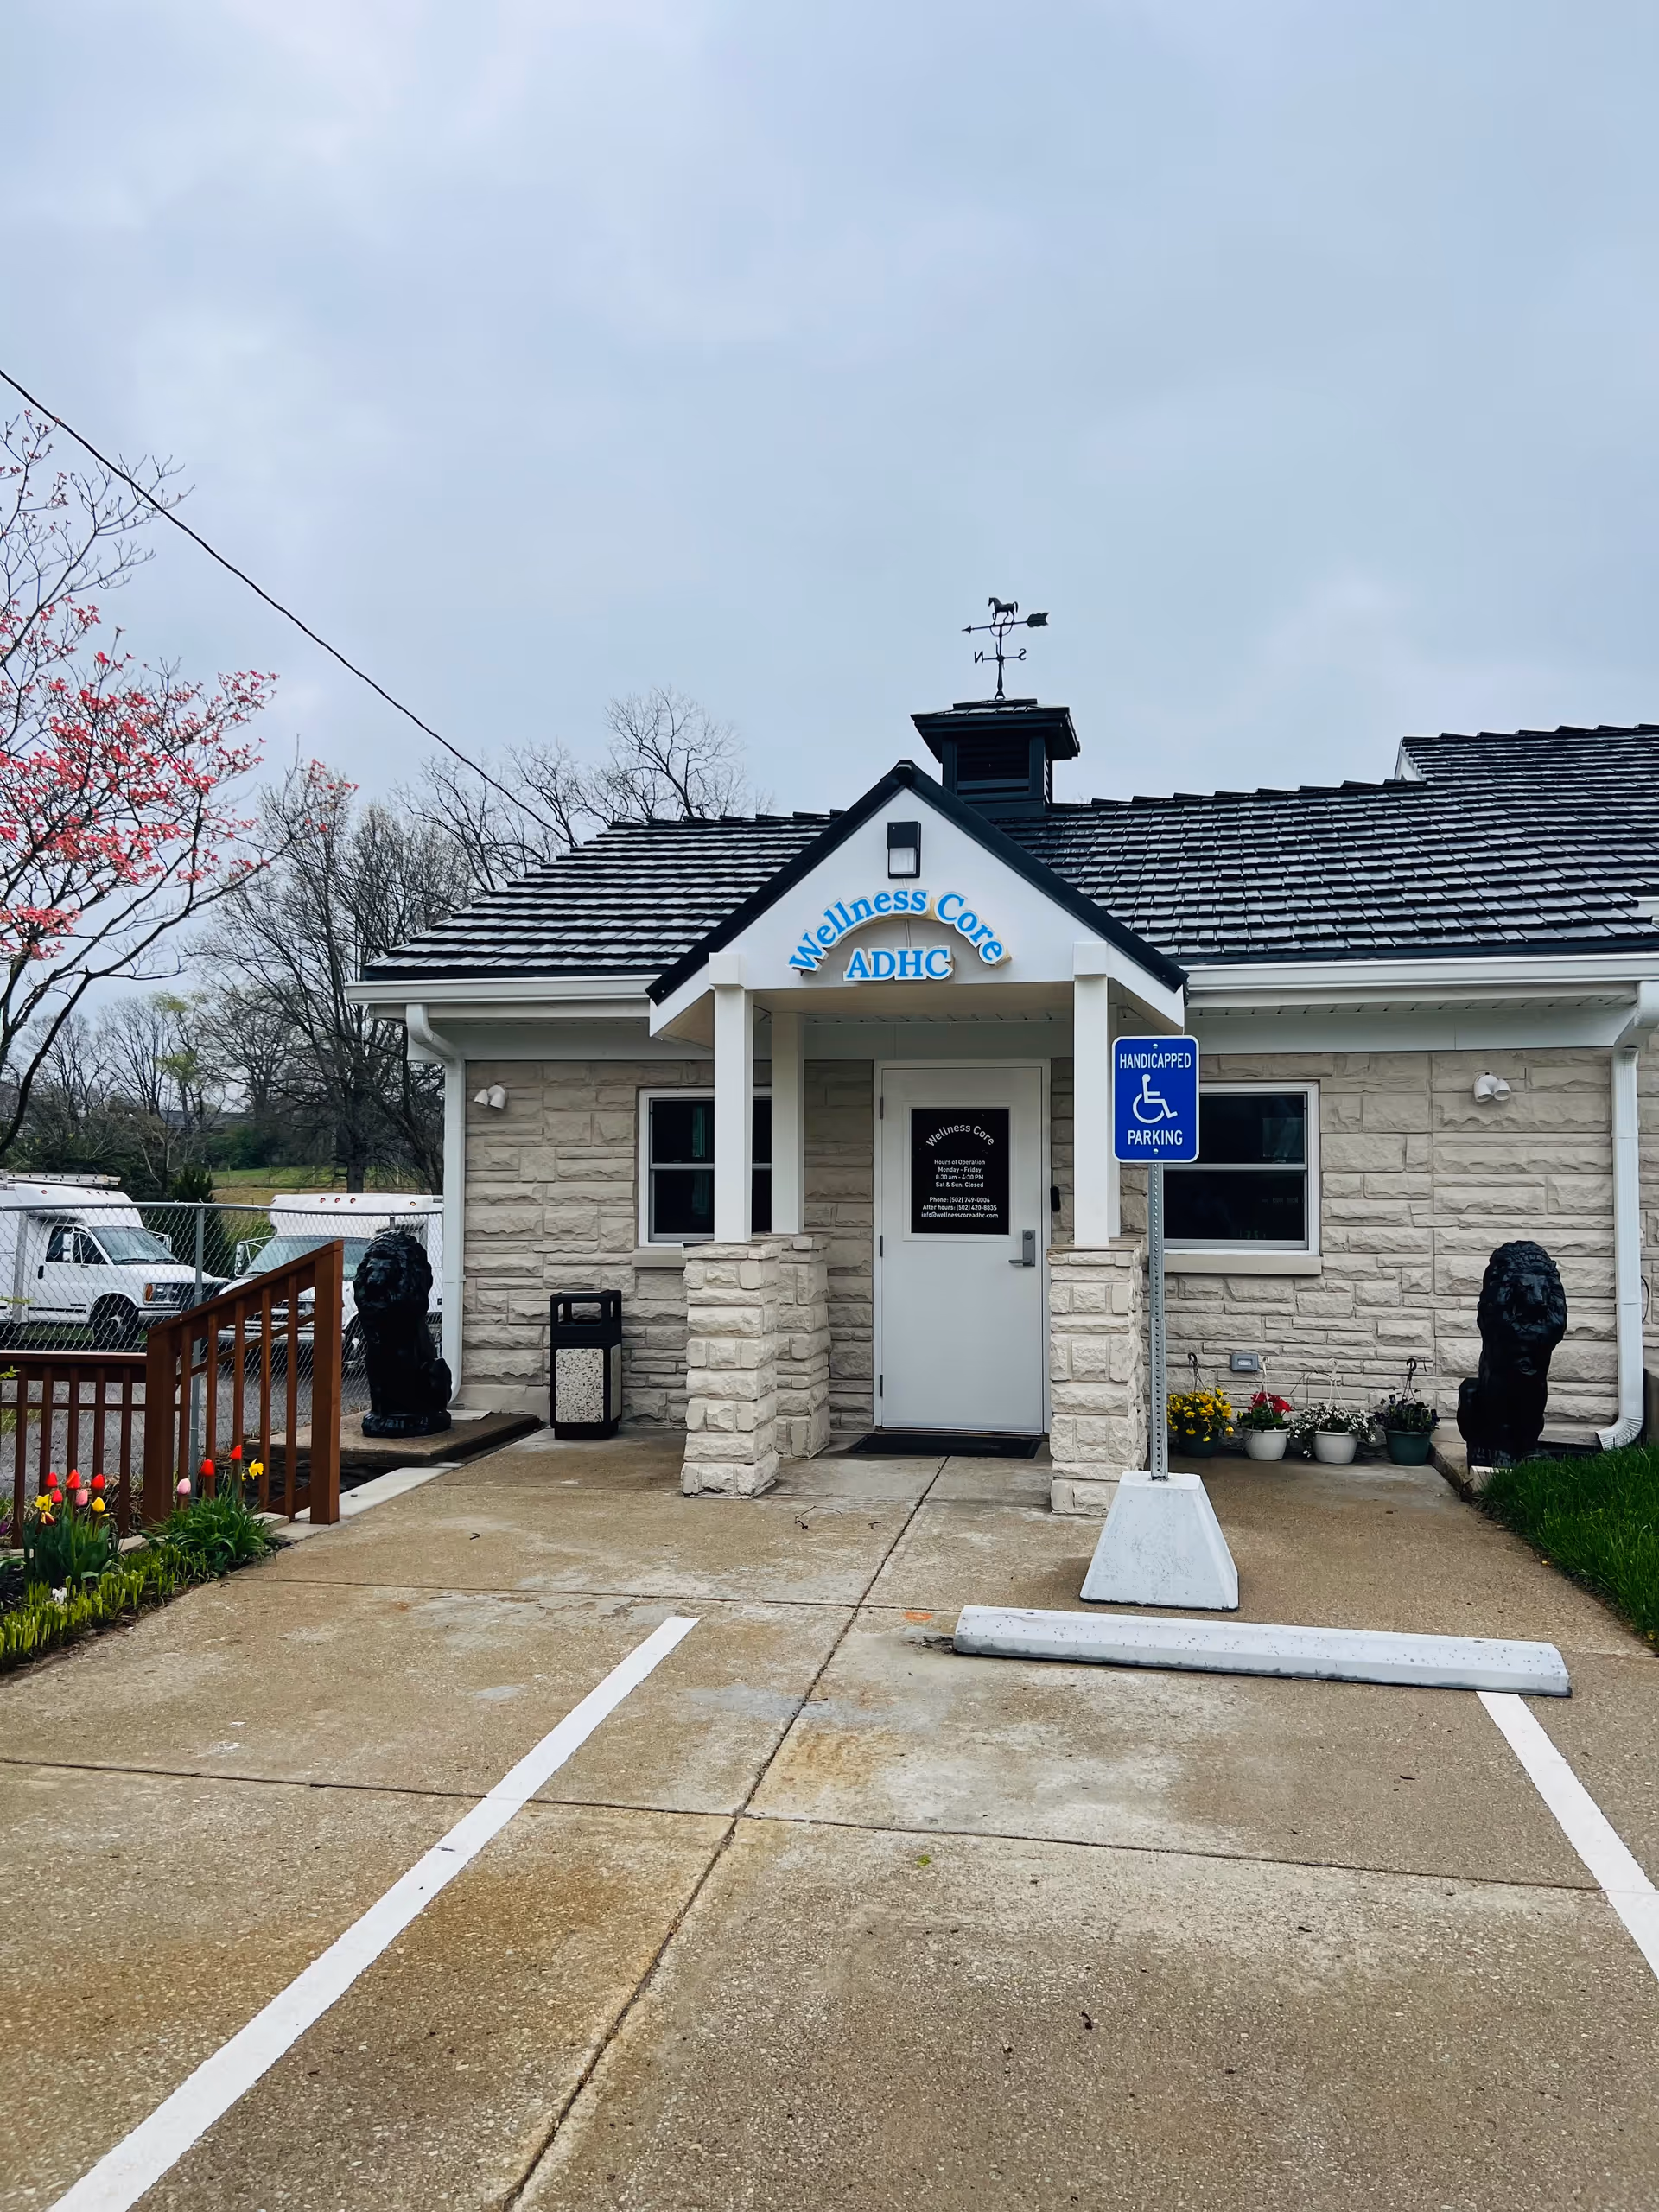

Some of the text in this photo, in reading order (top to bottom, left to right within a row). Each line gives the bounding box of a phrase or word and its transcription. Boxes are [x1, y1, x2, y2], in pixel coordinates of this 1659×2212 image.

[789, 890, 1004, 970] Wellness Core
[846, 949, 949, 979] ADHC
[1120, 1053, 1192, 1069] HANDICAPPED
[926, 1124, 995, 1147] Wellness Core
[1128, 1129, 1183, 1146] PARKING
